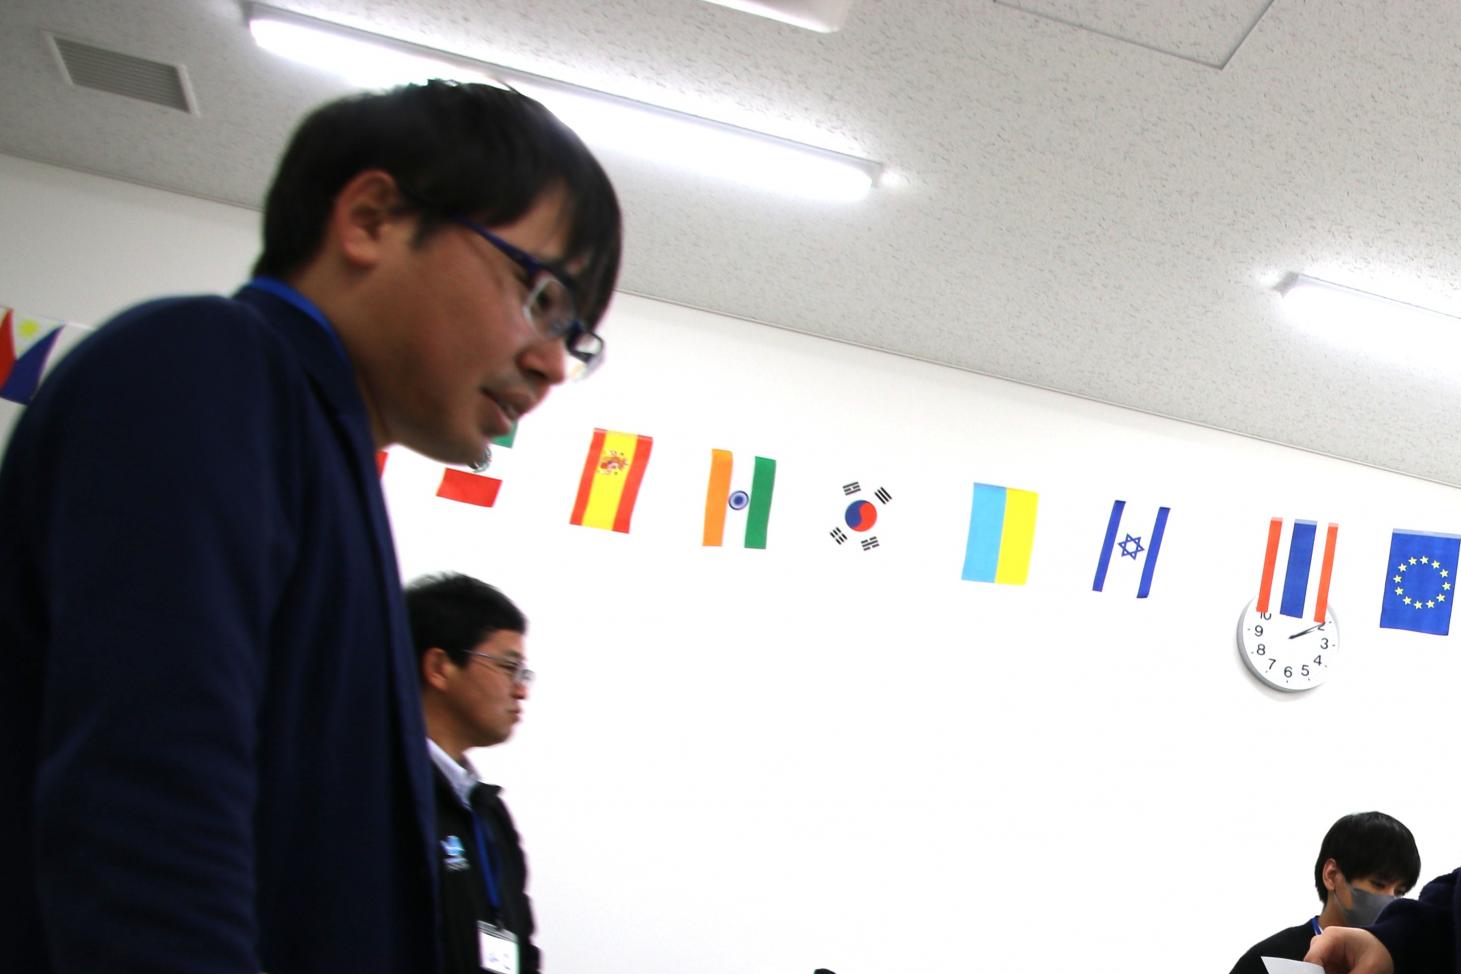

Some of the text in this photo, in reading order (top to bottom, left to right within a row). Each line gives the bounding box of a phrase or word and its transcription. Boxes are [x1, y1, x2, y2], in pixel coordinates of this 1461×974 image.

[1254, 625, 1264, 637] 9
[1320, 638, 1329, 649] 3
[1256, 644, 1266, 656] 8
[1267, 659, 1277, 670] 7
[1313, 655, 1322, 666] 4
[1283, 666, 1293, 678] 6
[1301, 665, 1310, 677] 5
